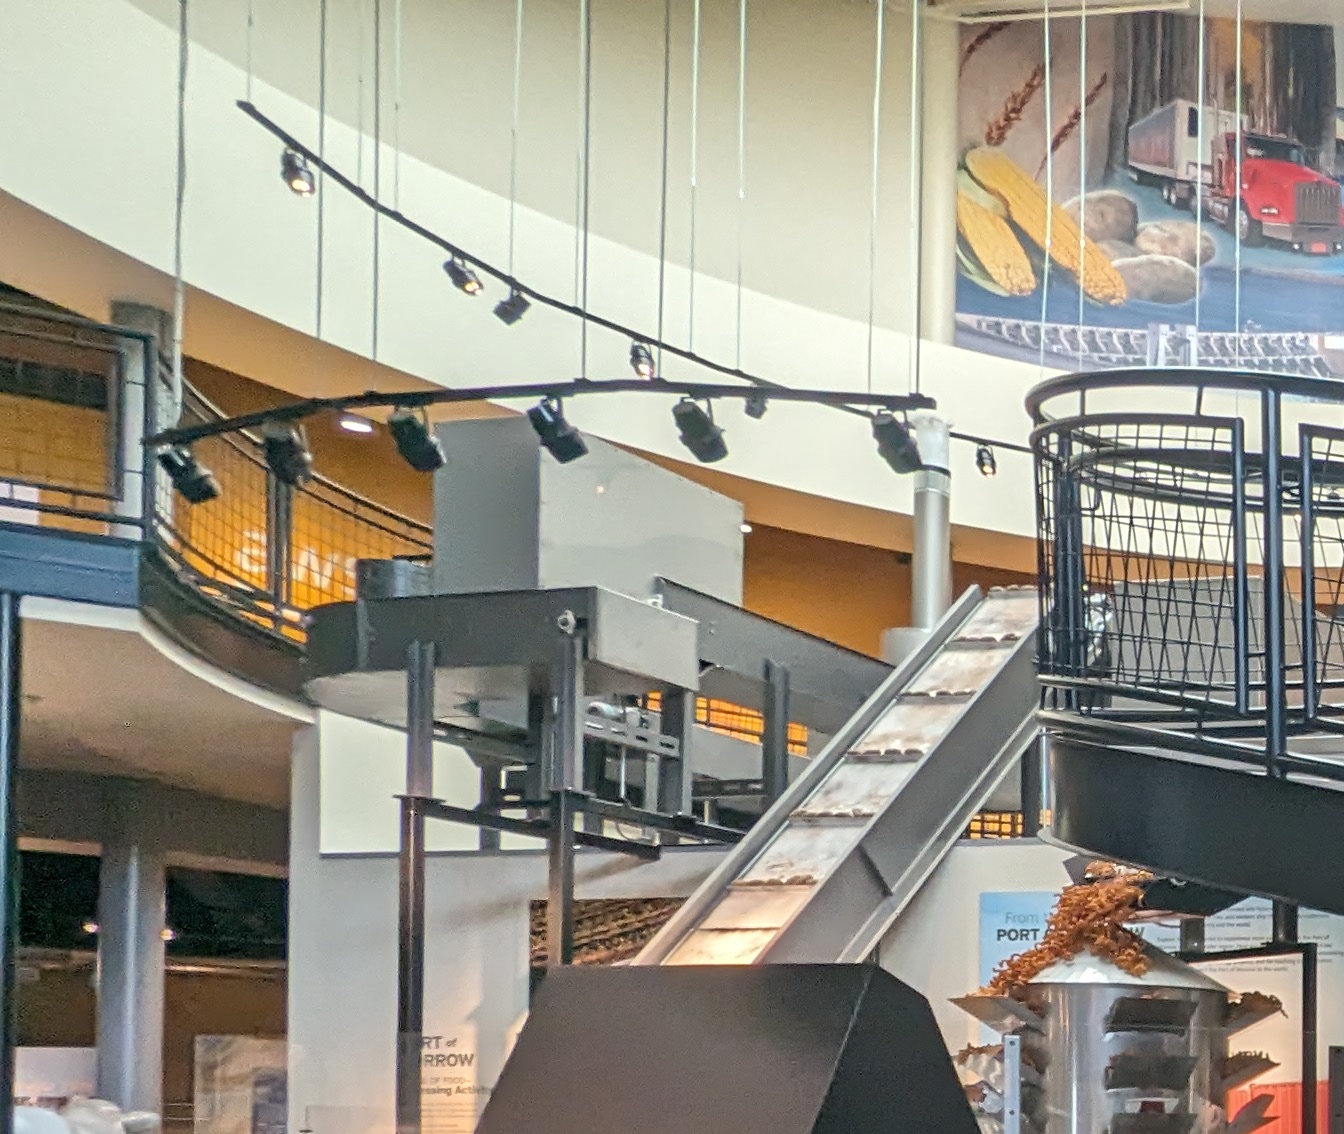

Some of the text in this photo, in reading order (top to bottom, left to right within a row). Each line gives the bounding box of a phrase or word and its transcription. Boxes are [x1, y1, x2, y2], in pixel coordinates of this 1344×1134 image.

[1005, 911, 1039, 924] From
[997, 928, 1040, 942] PORT
[422, 1036, 443, 1049] RT
[423, 1053, 475, 1068] RROW
